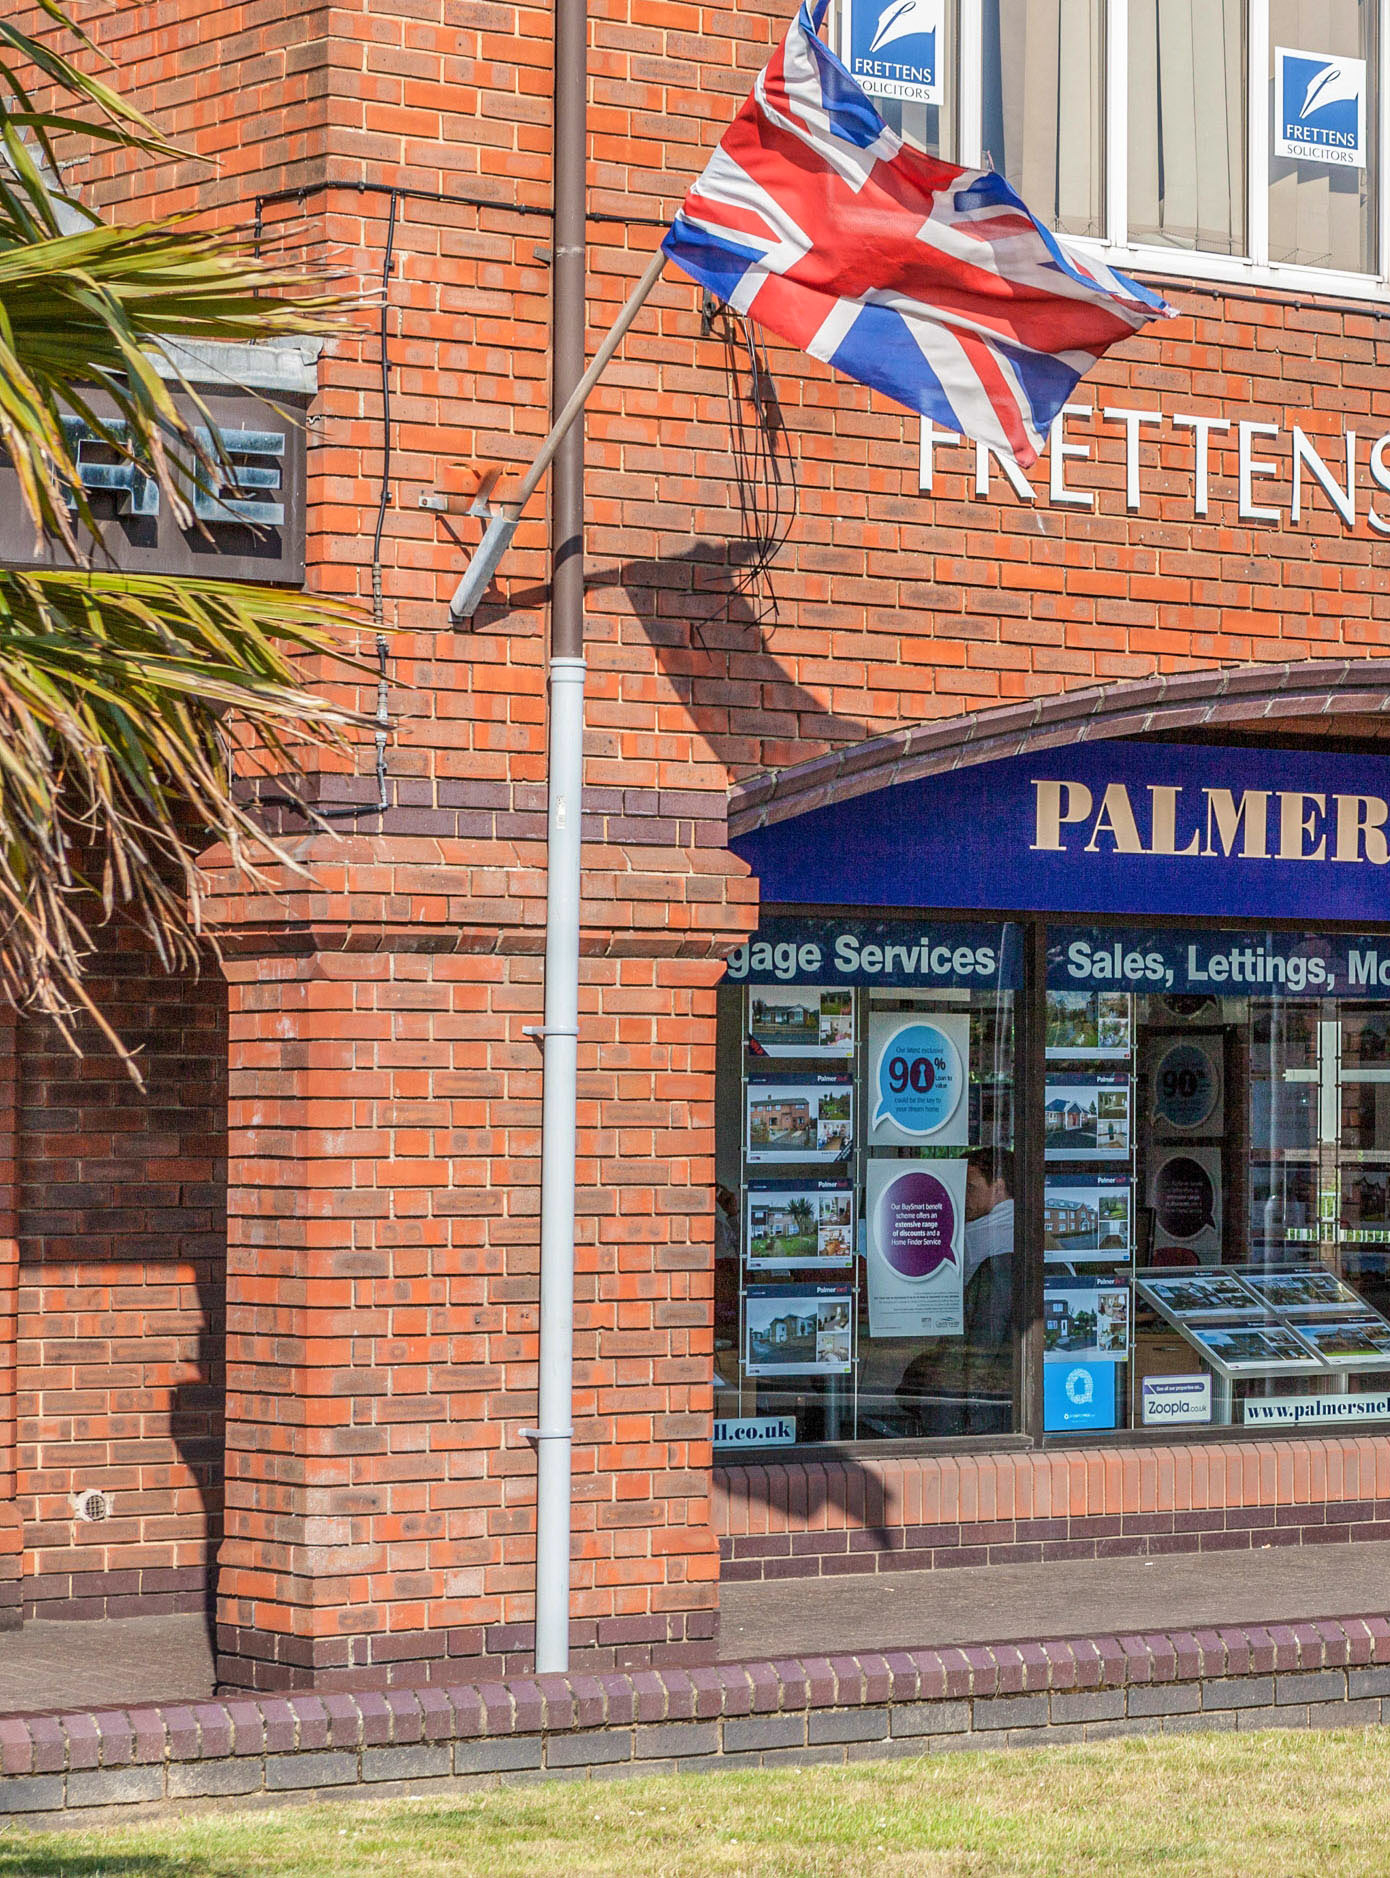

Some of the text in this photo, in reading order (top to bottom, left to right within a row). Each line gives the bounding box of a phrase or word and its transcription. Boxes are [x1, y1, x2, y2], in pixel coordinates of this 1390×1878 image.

[855, 58, 932, 83] FRETTENS
[857, 79, 931, 100] OLICITORS
[1286, 124, 1355, 147] FRETTENS
[1287, 144, 1354, 163] SOLICITORS
[834, 934, 996, 976] Services
[1066, 941, 1175, 988] Sales,
[1188, 946, 1336, 992] Lettings,
[1148, 1399, 1207, 1416] Zoopla.co.uk
